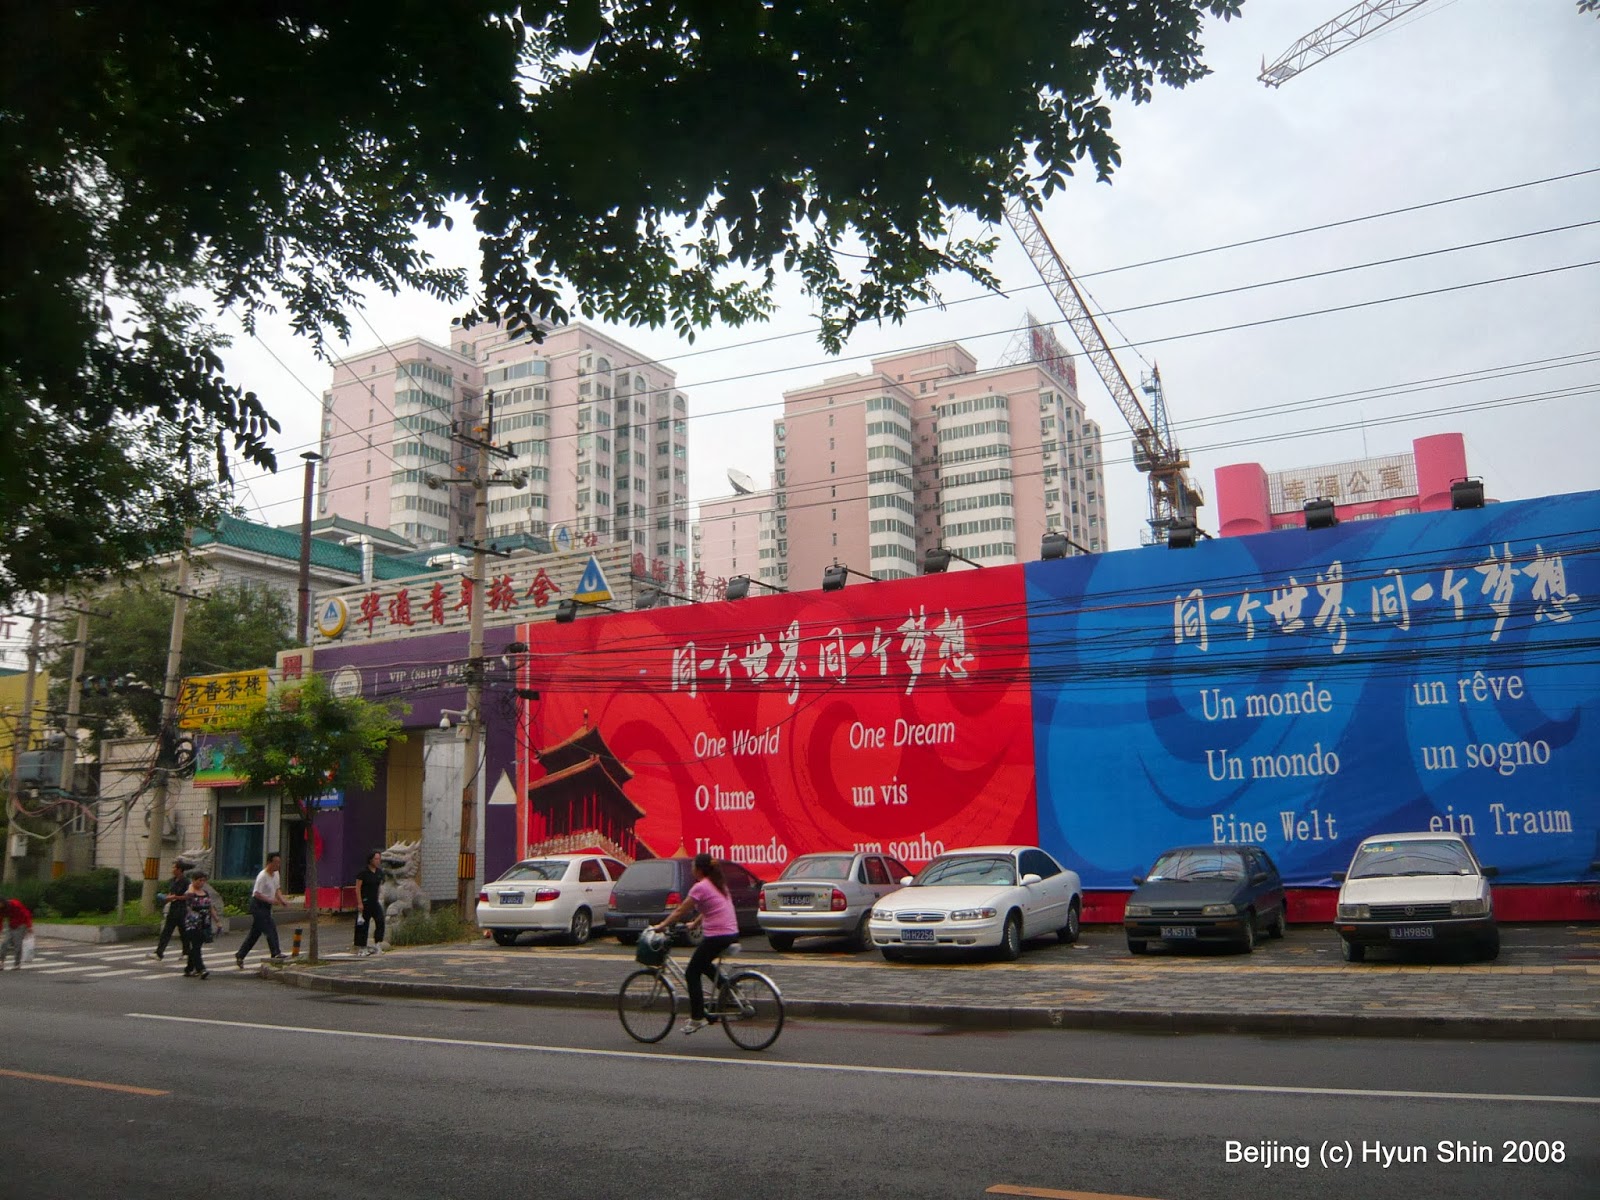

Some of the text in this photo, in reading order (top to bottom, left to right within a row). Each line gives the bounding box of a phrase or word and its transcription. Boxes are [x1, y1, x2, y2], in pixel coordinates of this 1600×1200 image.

[1284, 465, 1404, 502] 幸福公寓
[1200, 670, 1524, 721] Un monde un rêve
[694, 718, 956, 758] One World One Dream
[1206, 739, 1551, 781] Un mondo un sogno
[695, 775, 909, 811] O lume un vis
[1211, 802, 1573, 844] Eine Welt ein Traum
[730, 836, 788, 864] mundo
[888, 832, 945, 862] sonho
